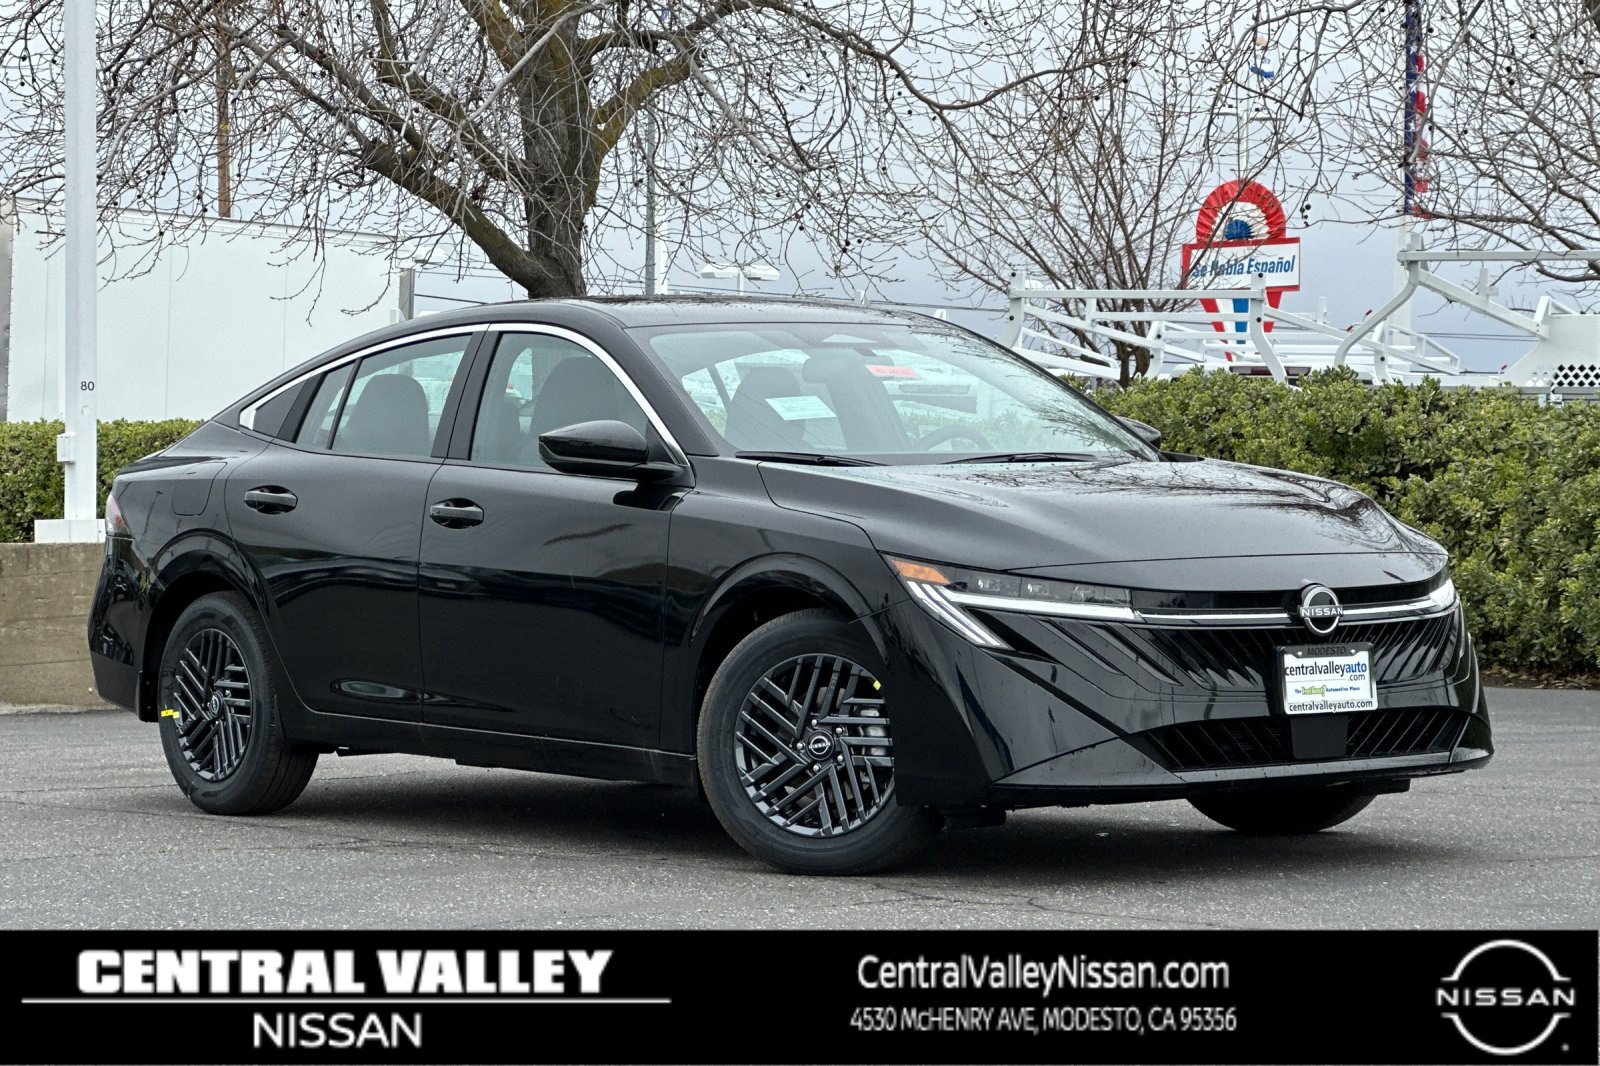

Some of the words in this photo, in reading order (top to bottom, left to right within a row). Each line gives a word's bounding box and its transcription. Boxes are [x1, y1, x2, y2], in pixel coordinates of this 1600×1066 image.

[1247, 254, 1296, 275] Español
[80, 381, 94, 391] 80
[1301, 607, 1343, 617] NISSAN
[1307, 646, 1346, 656] MODESTO
[1285, 661, 1367, 677] centralvalleyauto
[1289, 700, 1373, 712] centralvalleyauto.com
